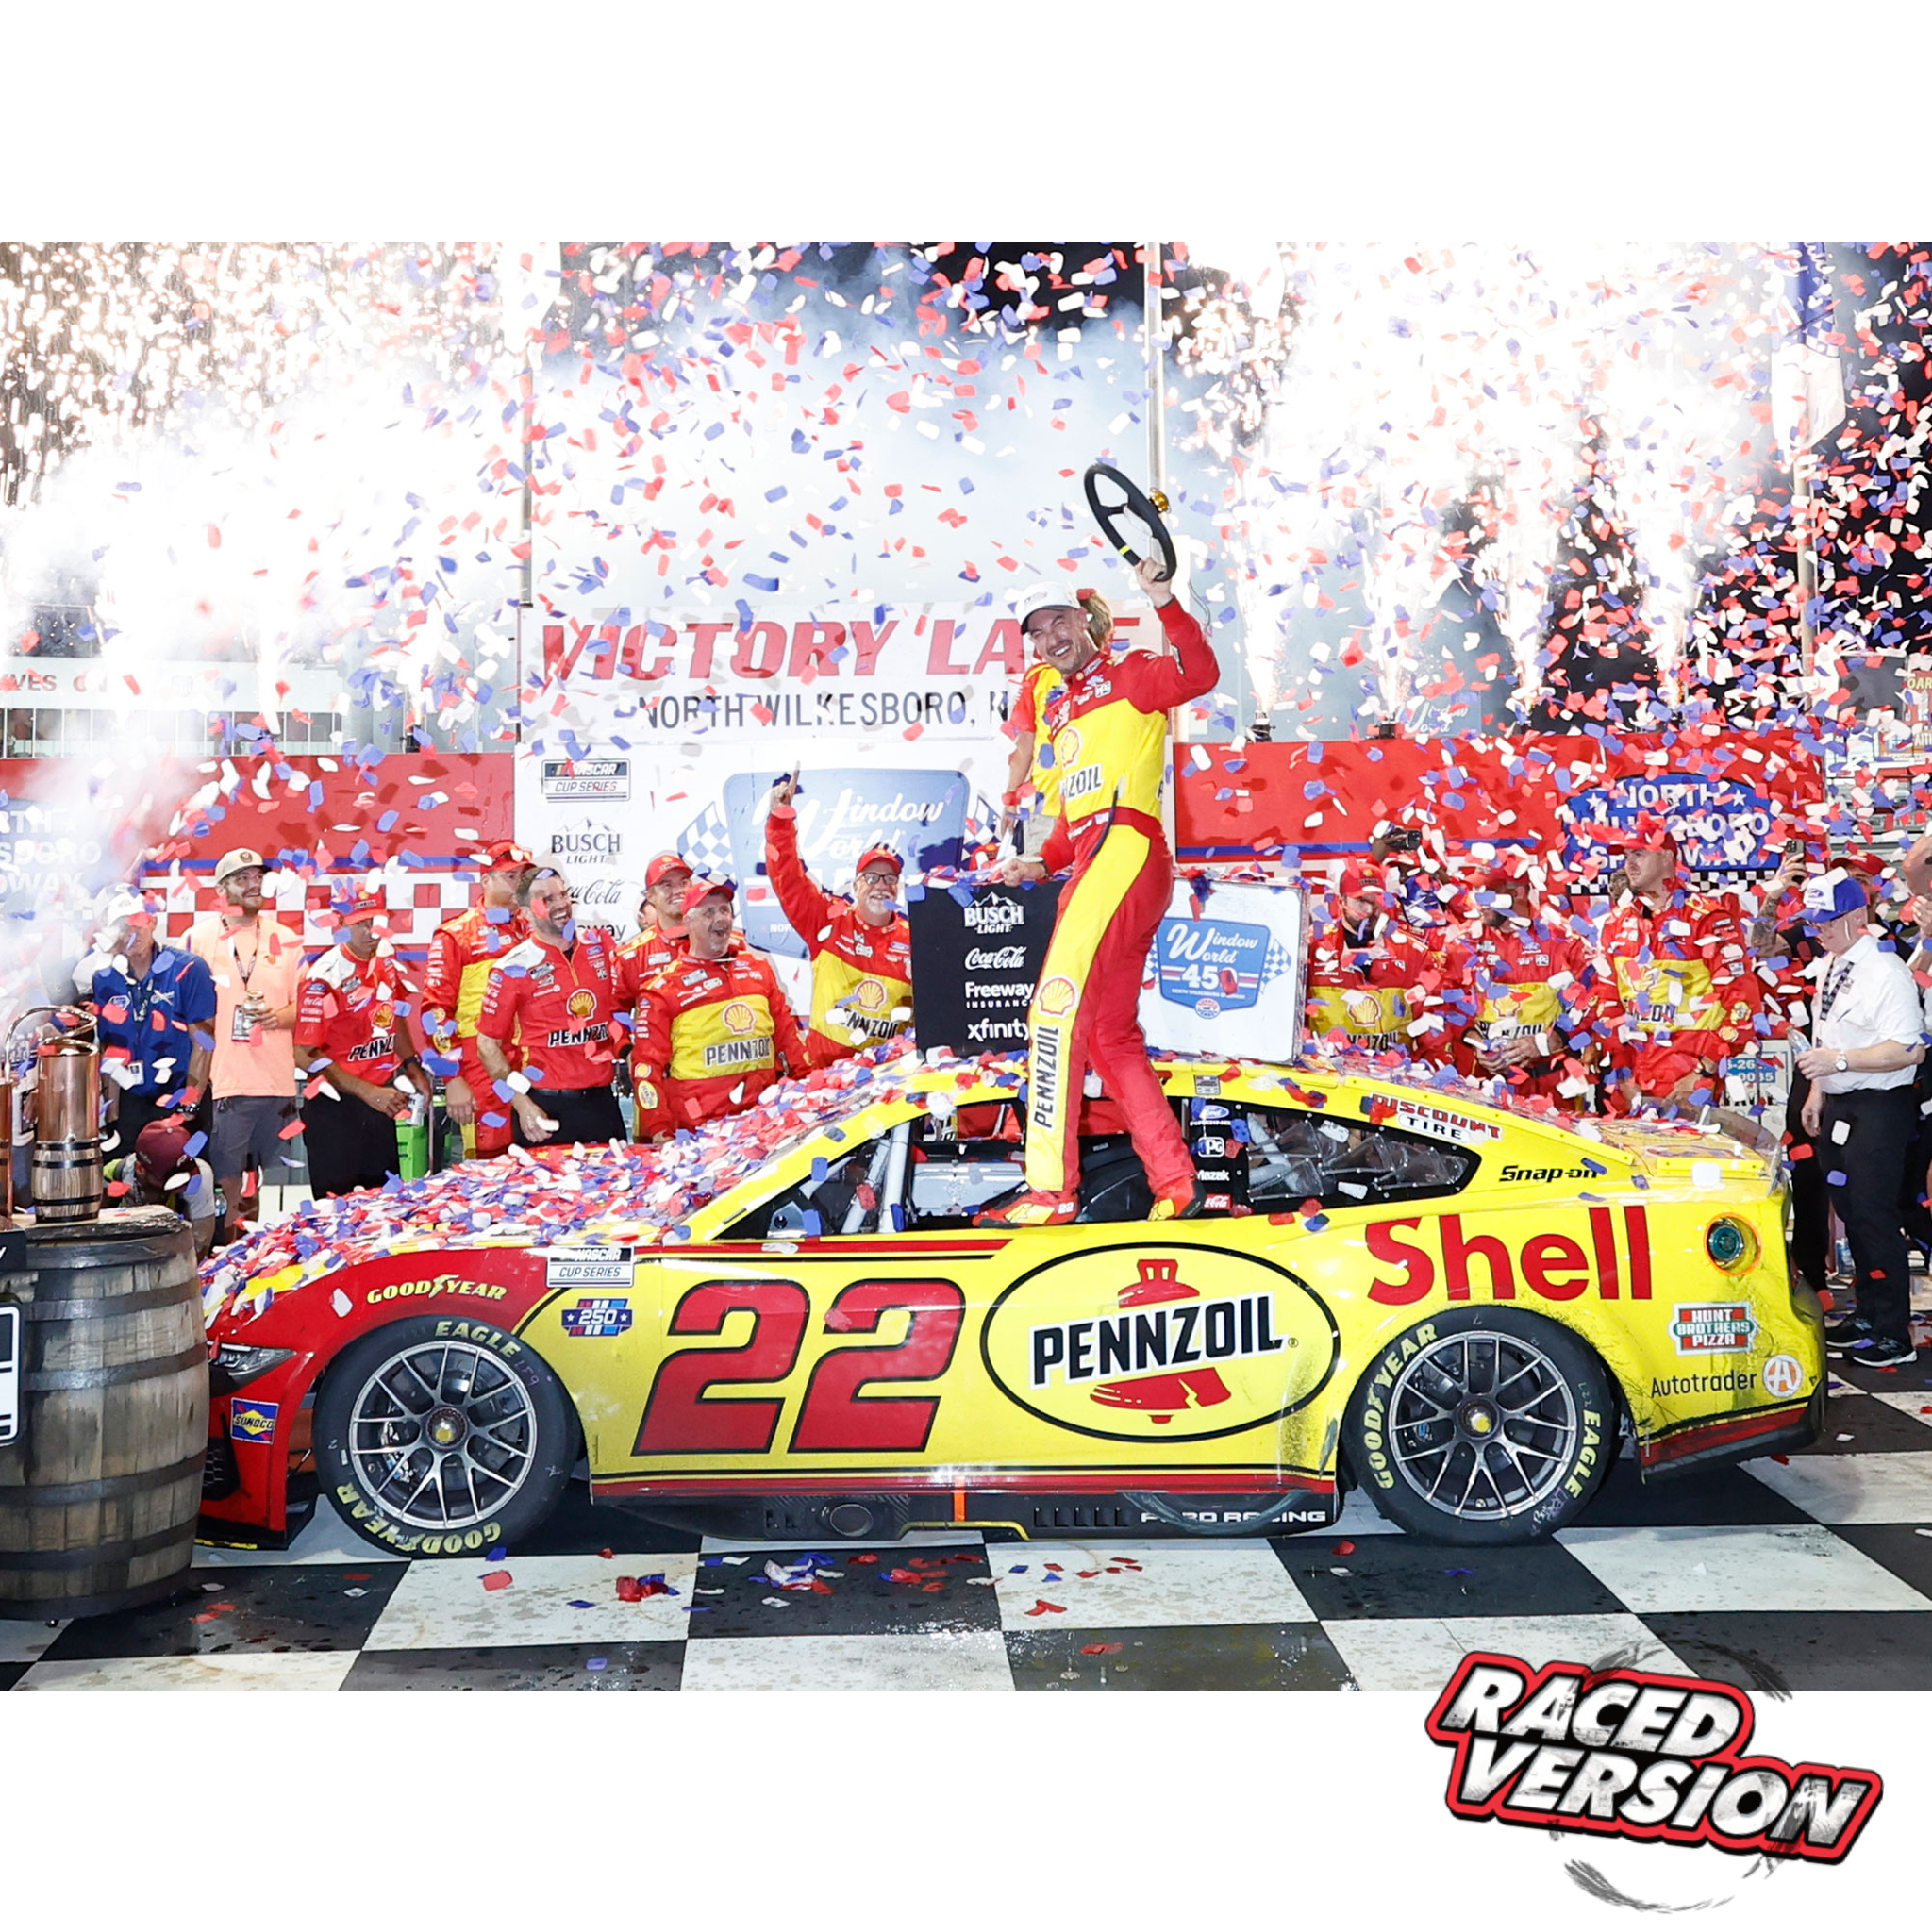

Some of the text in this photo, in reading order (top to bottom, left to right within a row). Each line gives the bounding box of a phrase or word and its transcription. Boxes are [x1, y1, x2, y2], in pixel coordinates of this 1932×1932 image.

[542, 617, 1140, 681] VICTORY LAE
[639, 693, 743, 728] NORTH
[555, 781, 618, 792] CUP SERIES
[551, 834, 621, 853] BUSCH
[566, 855, 608, 864] LIGHT
[964, 906, 1024, 927] BUSCH
[977, 924, 1010, 934] LIGHT
[1166, 923, 1259, 961] Window
[964, 946, 1027, 970] Coca-Cola
[965, 981, 1035, 1000] Freeway
[966, 1000, 1034, 1009] INSURANC
[967, 1017, 1028, 1042] xfinity
[1034, 1025, 1059, 1129] PENNZOIL
[1372, 1093, 1503, 1140] DISCOUNT
[1408, 1117, 1463, 1140] TIRE
[1499, 1164, 1600, 1184] Snap-on
[1058, 1202, 1074, 1214] 22
[1367, 1204, 1653, 1306] Shell
[559, 1266, 622, 1278] CUP SERIES
[367, 1274, 508, 1304] GOODYEAR
[578, 1308, 618, 1324] 250
[1691, 1309, 1733, 1322] HUNT
[435, 1320, 521, 1358] EAGLE
[1676, 1321, 1750, 1336] BROTHERS
[1691, 1333, 1736, 1347] PIZZA
[1035, 1295, 1283, 1388] PENNZOIL
[631, 1278, 966, 1456] 22
[1651, 1370, 1757, 1398] Autotrader
[1363, 1322, 1438, 1490] GOODYEAR
[235, 1415, 274, 1429] SUNOCO
[1564, 1408, 1602, 1499] EAGLE
[336, 1482, 503, 1555] GOODYEAR
